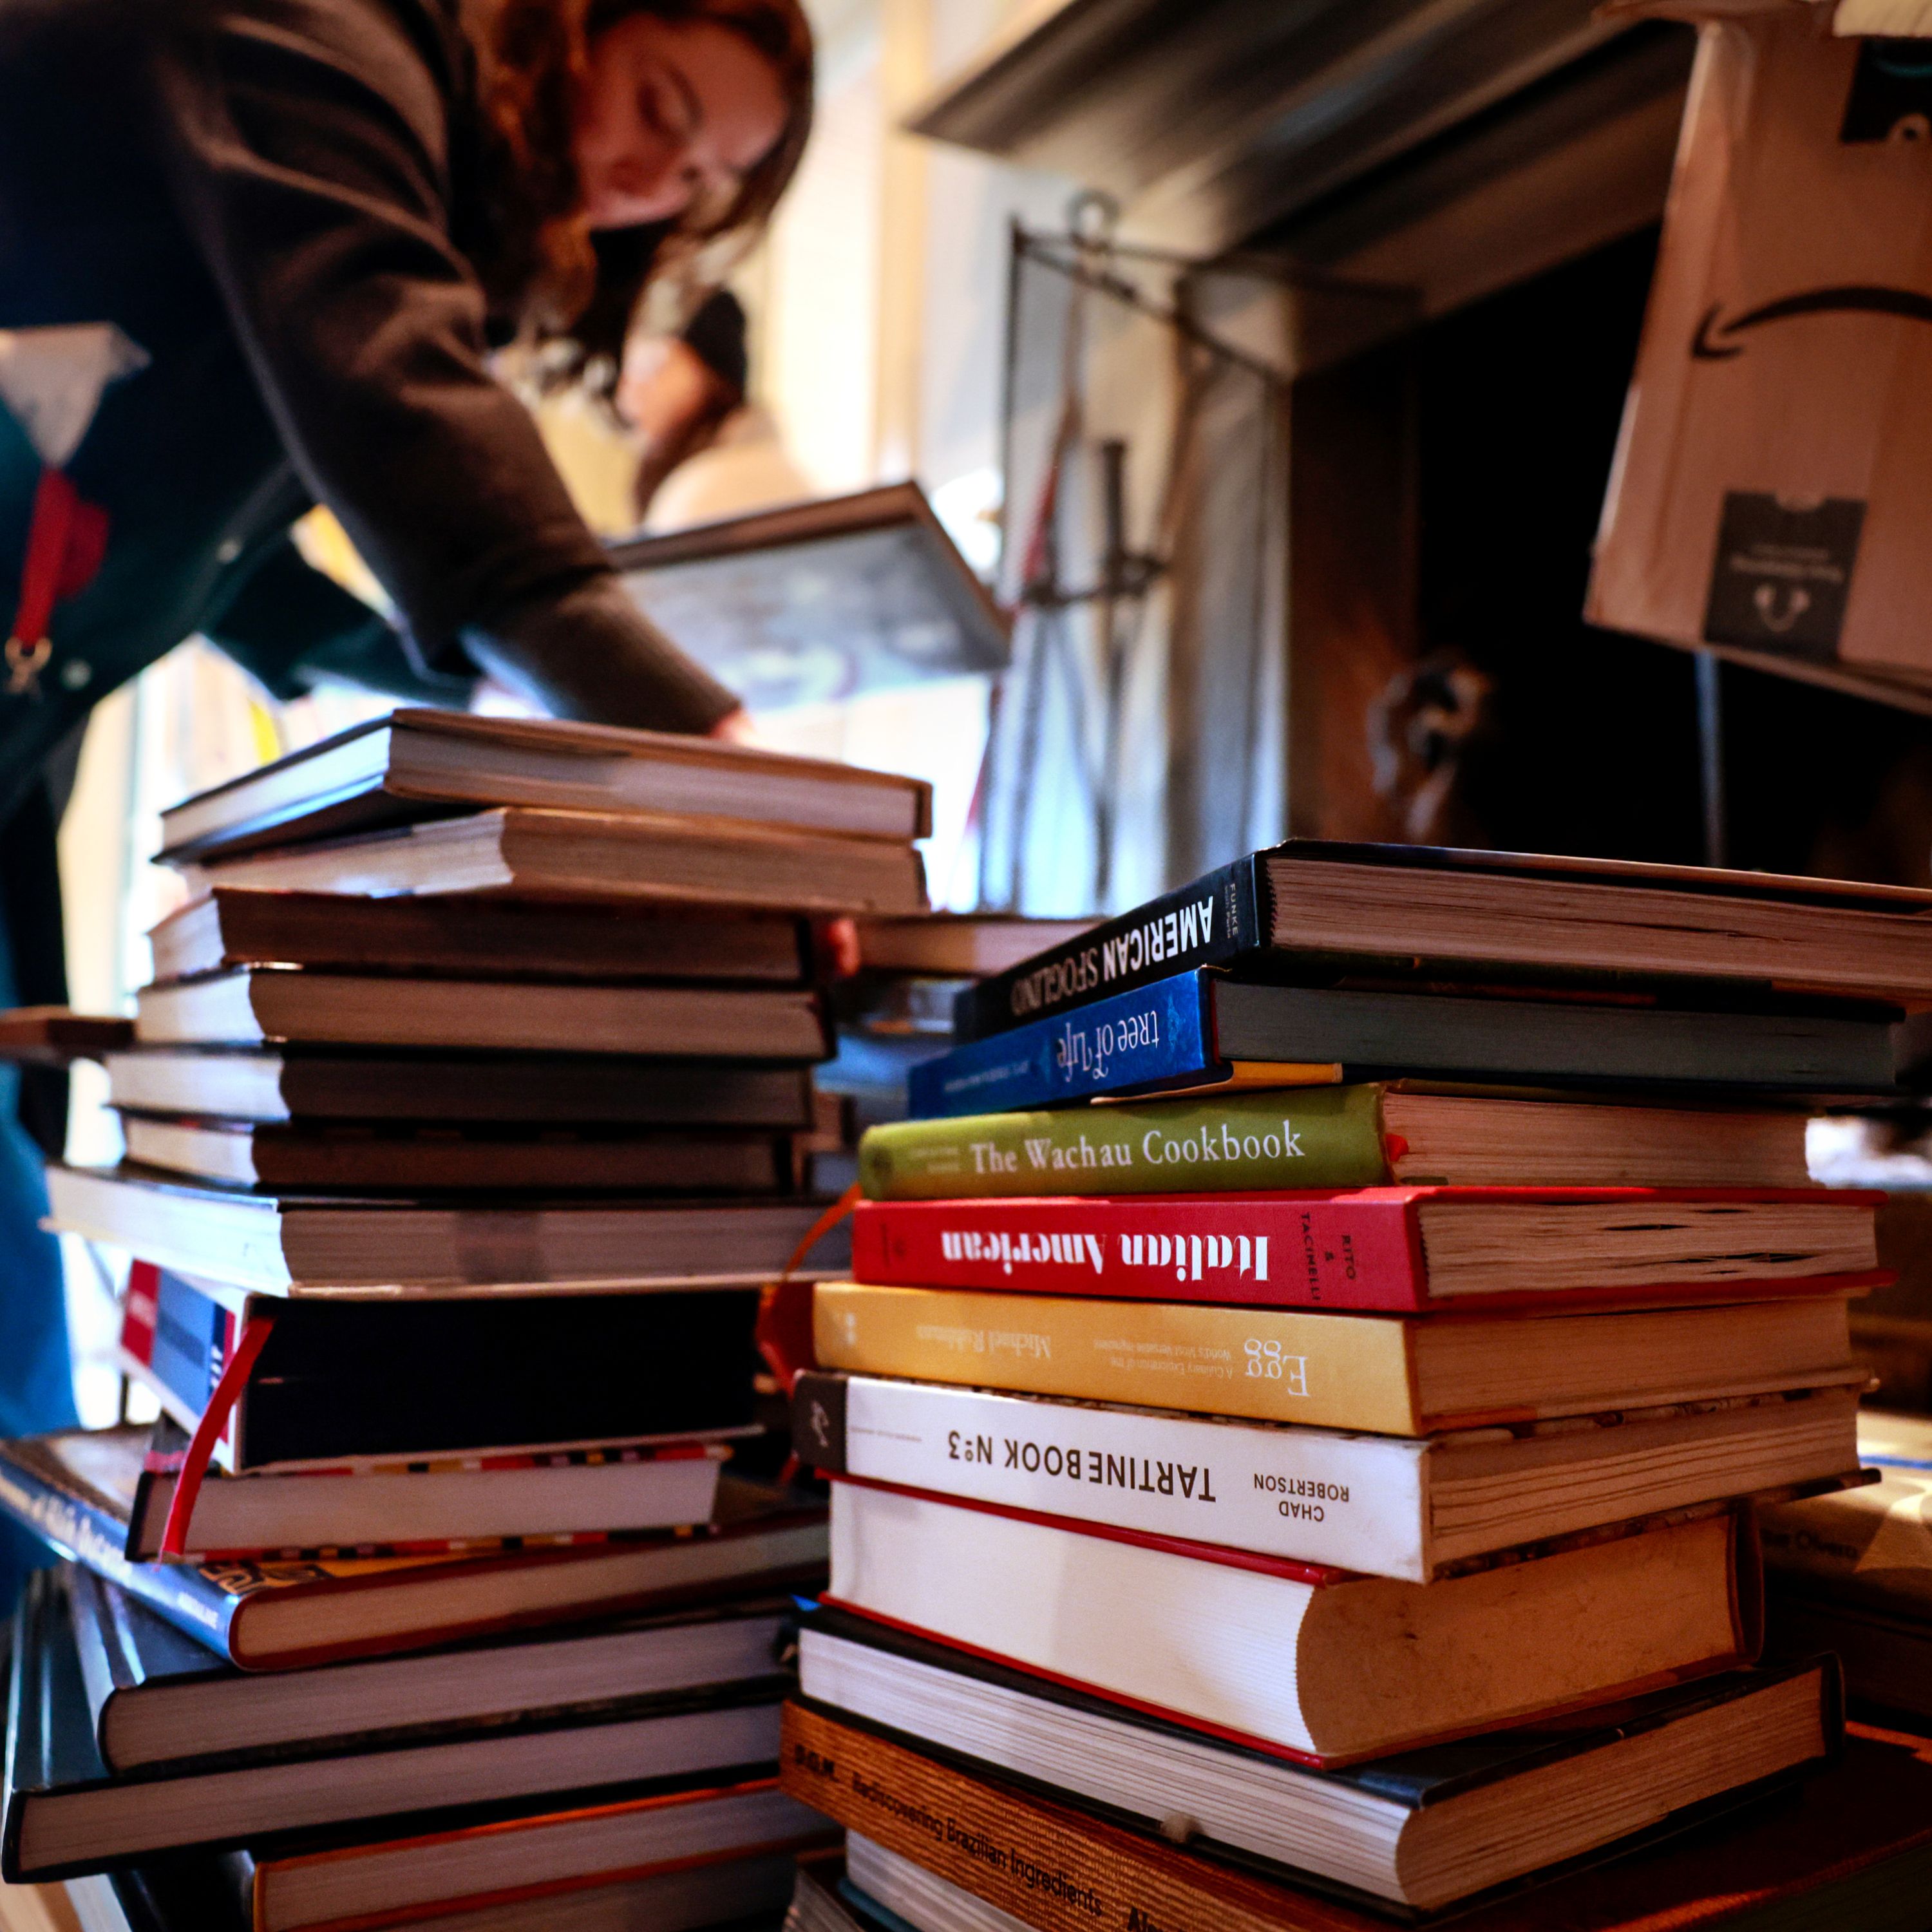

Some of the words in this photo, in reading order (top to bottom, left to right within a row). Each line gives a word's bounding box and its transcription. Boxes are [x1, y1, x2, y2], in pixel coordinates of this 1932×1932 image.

[1229, 882, 1238, 936] FUNKE
[1103, 896, 1213, 981] AMERICAN
[969, 1141, 1018, 1175] The
[1024, 1134, 1133, 1171] Wachau
[1142, 1120, 1305, 1164] Cookbook
[941, 1231, 1107, 1276] American
[1117, 1233, 1271, 1282] Italian
[1341, 1235, 1356, 1280] RITO
[987, 1329, 1052, 1359] Michael
[1244, 1338, 1310, 1397] Egg
[1003, 1439, 1082, 1481] BOOK
[1088, 1451, 1217, 1502] TARTINE
[1253, 1472, 1350, 1502] ROBERTSON
[1278, 1500, 1325, 1522] CHAD
[946, 1816, 1009, 1870] Brazilian
[1010, 1847, 1103, 1918] Ingredients
